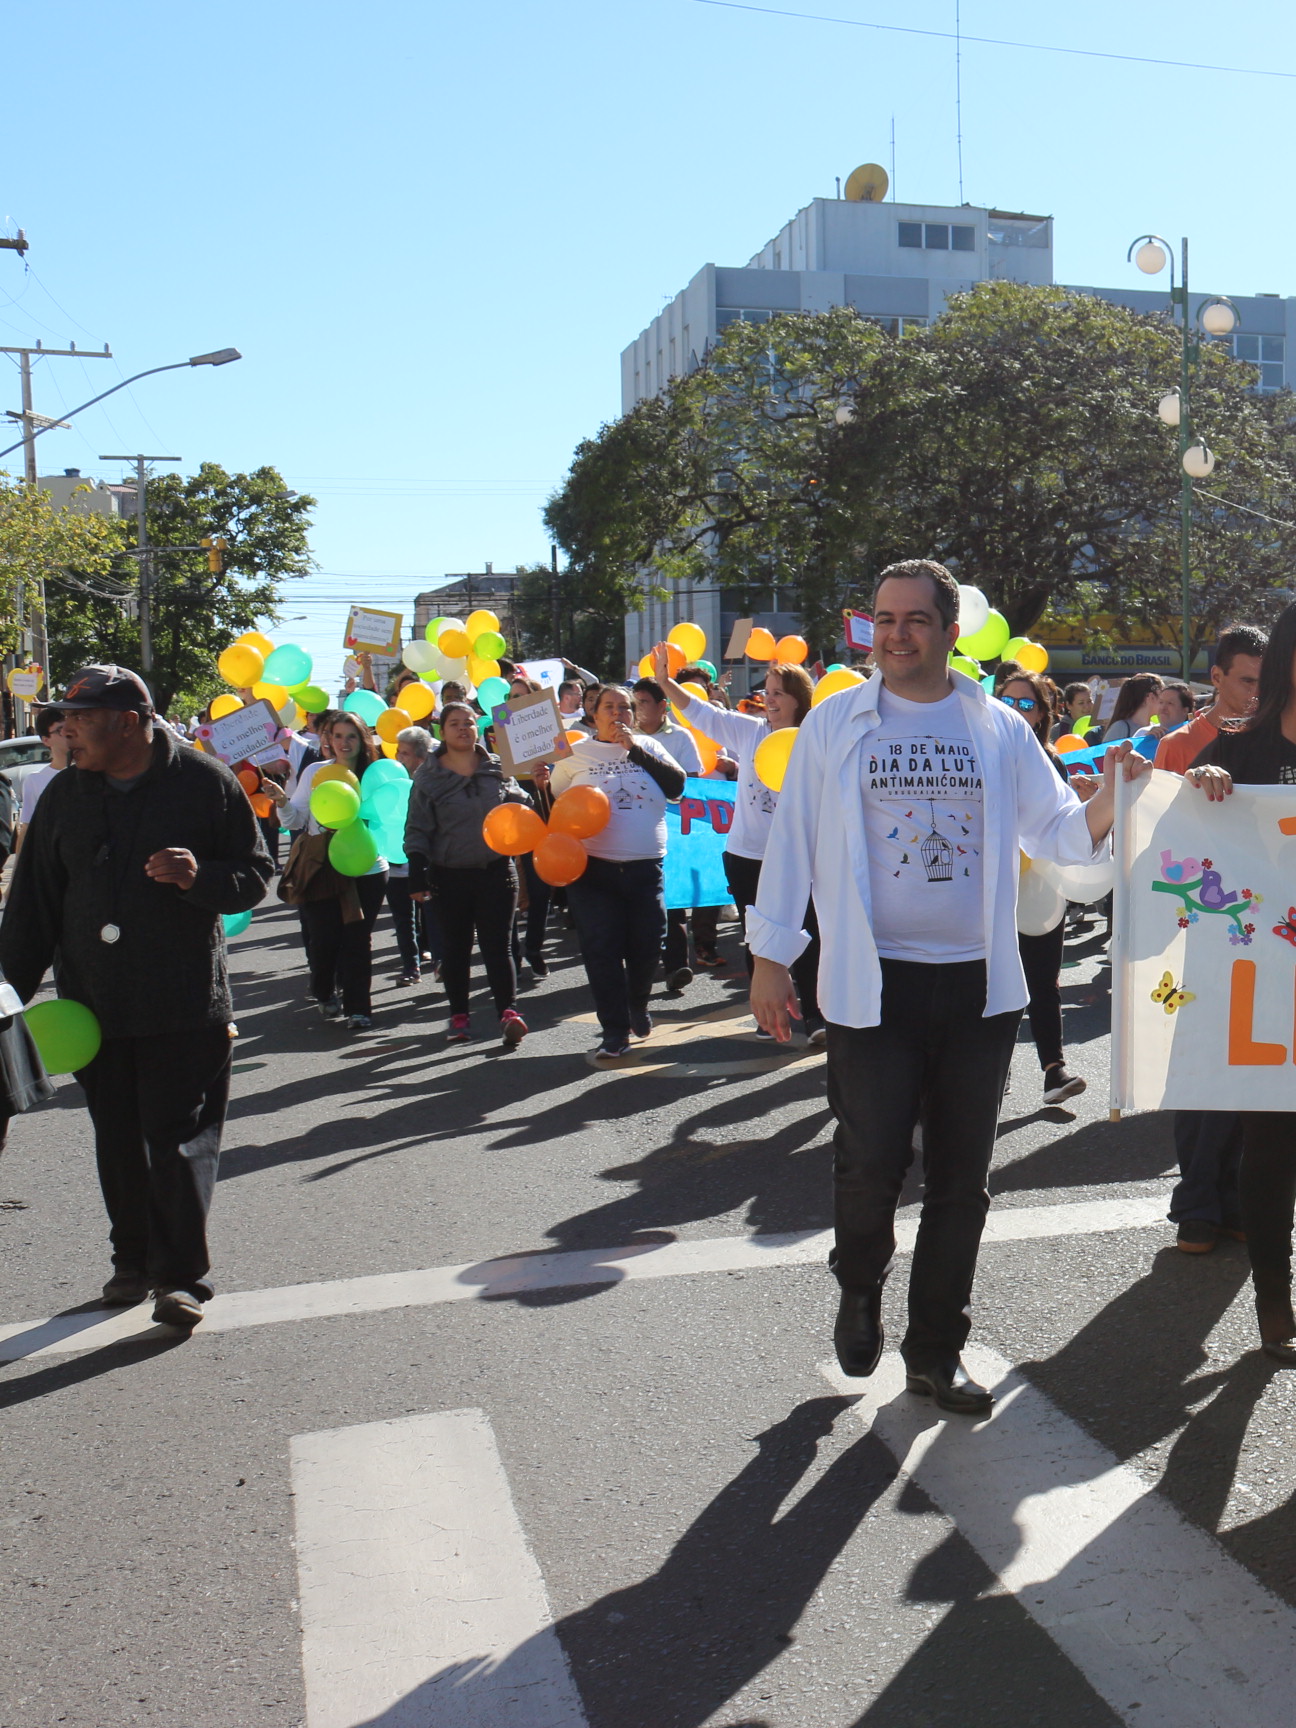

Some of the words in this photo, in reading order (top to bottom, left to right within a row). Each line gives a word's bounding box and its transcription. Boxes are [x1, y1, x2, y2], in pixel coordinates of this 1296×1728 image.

[1120, 655, 1135, 666] DO
[1136, 654, 1172, 666] BRASIL
[214, 708, 259, 735] Liberdade
[511, 706, 549, 726] Liberdade
[527, 723, 554, 738] melhor
[229, 738, 236, 746] o
[232, 736, 269, 760] cuidado!
[522, 739, 555, 758] cuidado!
[889, 744, 903, 756] 18
[911, 743, 927, 755] DE
[935, 744, 970, 756] MAIO
[869, 758, 900, 774] DIA
[908, 758, 933, 772] DA
[941, 757, 976, 773] LUT
[870, 776, 982, 789] ANTIMANICOMIA
